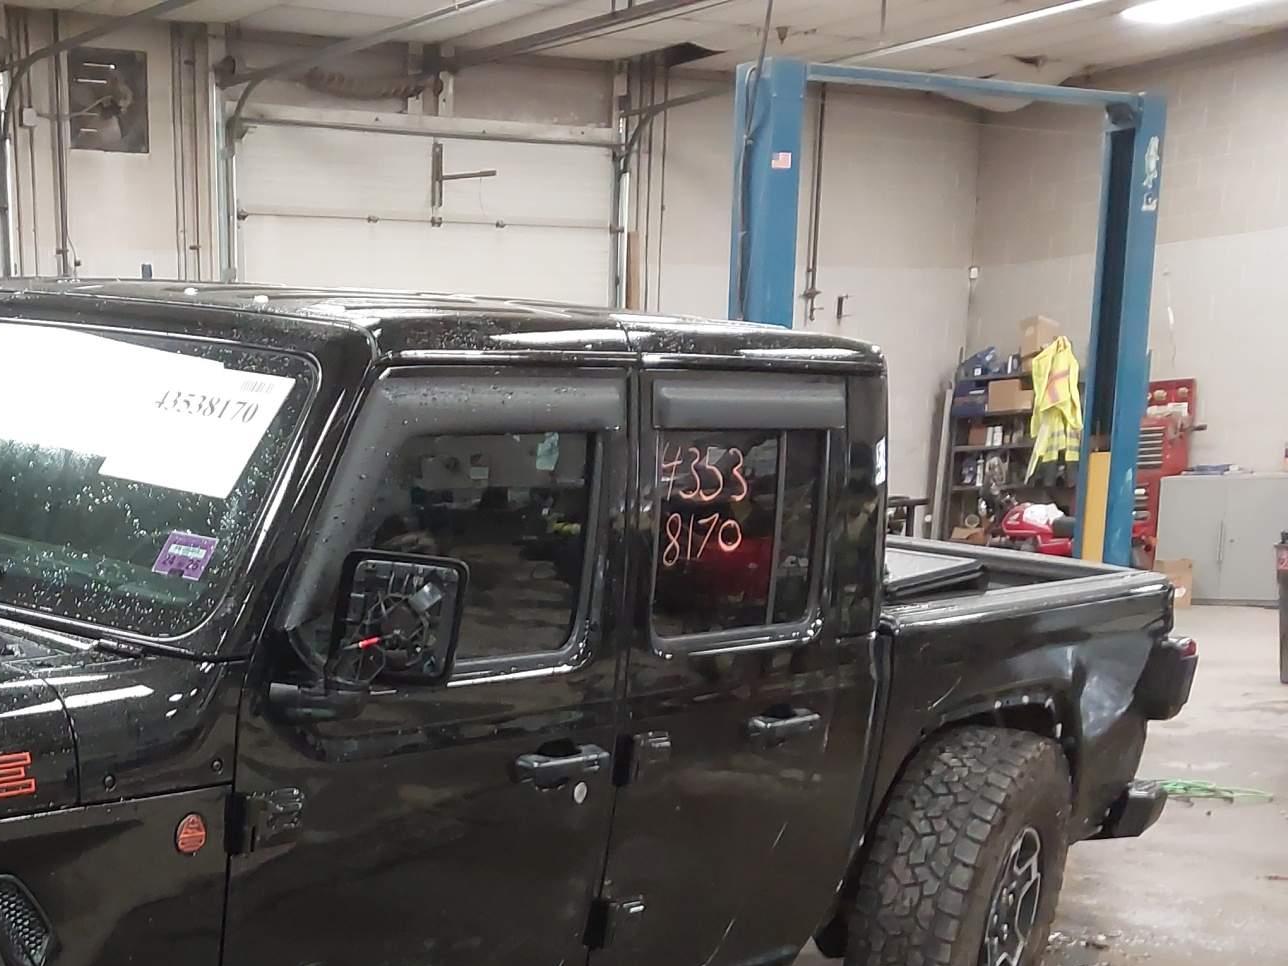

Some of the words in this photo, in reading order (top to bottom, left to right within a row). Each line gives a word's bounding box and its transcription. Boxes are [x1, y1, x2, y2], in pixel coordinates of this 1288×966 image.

[153, 390, 260, 423] 43538170
[661, 442, 747, 501] 4353
[662, 513, 742, 567] 8170
